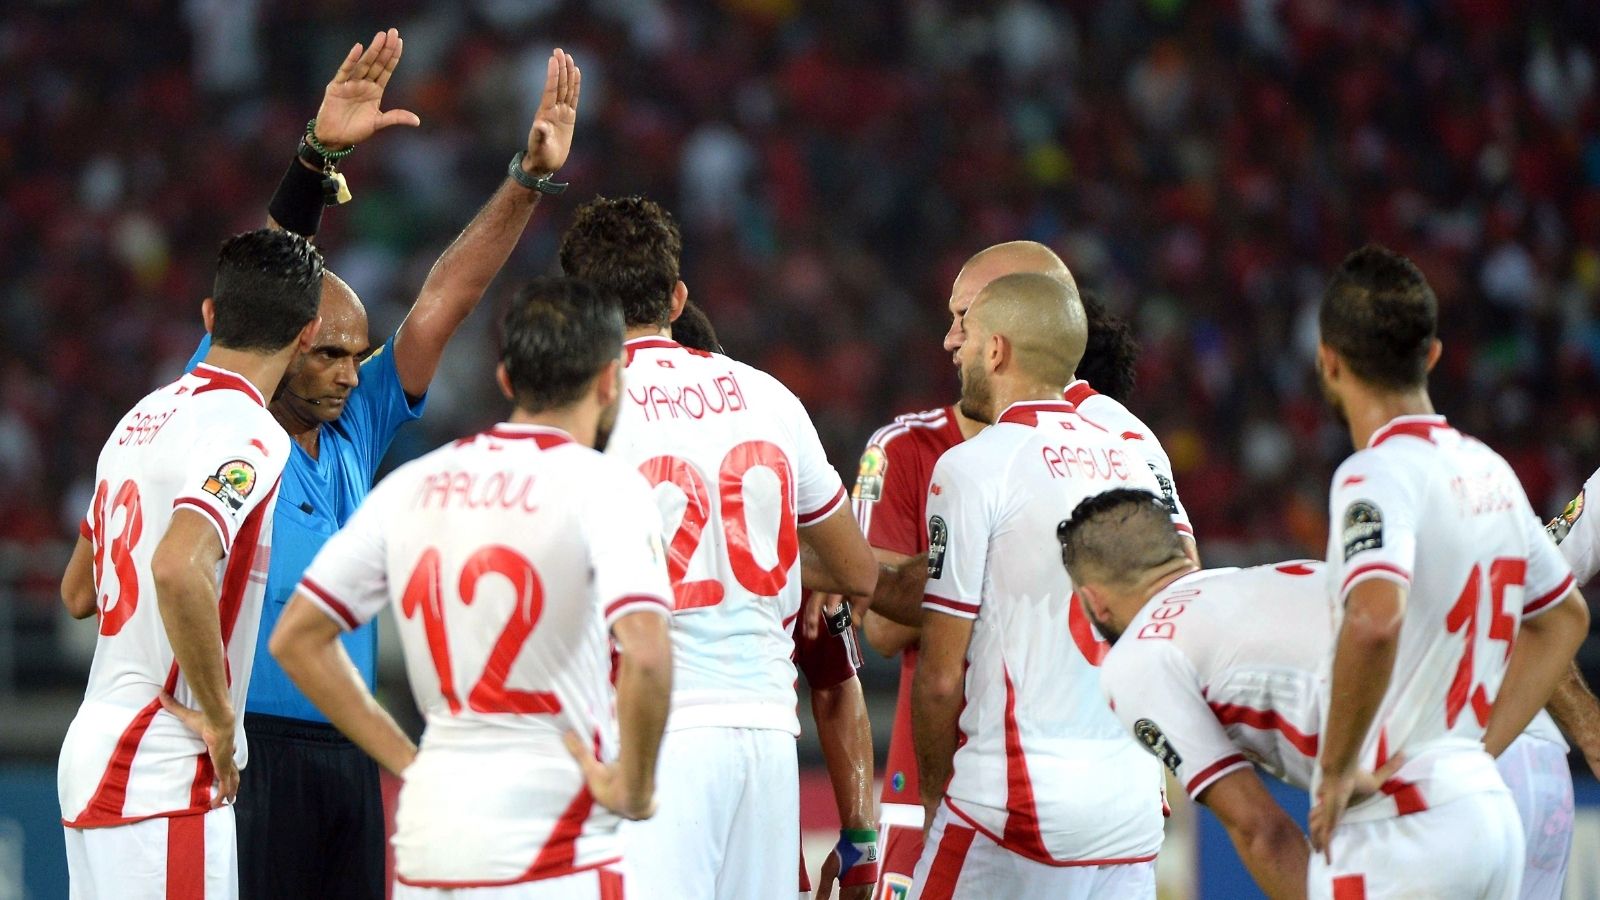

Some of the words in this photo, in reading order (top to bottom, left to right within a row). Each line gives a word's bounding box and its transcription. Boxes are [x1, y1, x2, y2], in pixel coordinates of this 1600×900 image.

[638, 440, 799, 610] 20
[1042, 445, 1132, 481] RAGUE
[401, 543, 562, 716] 12
[1445, 557, 1529, 731] 15
